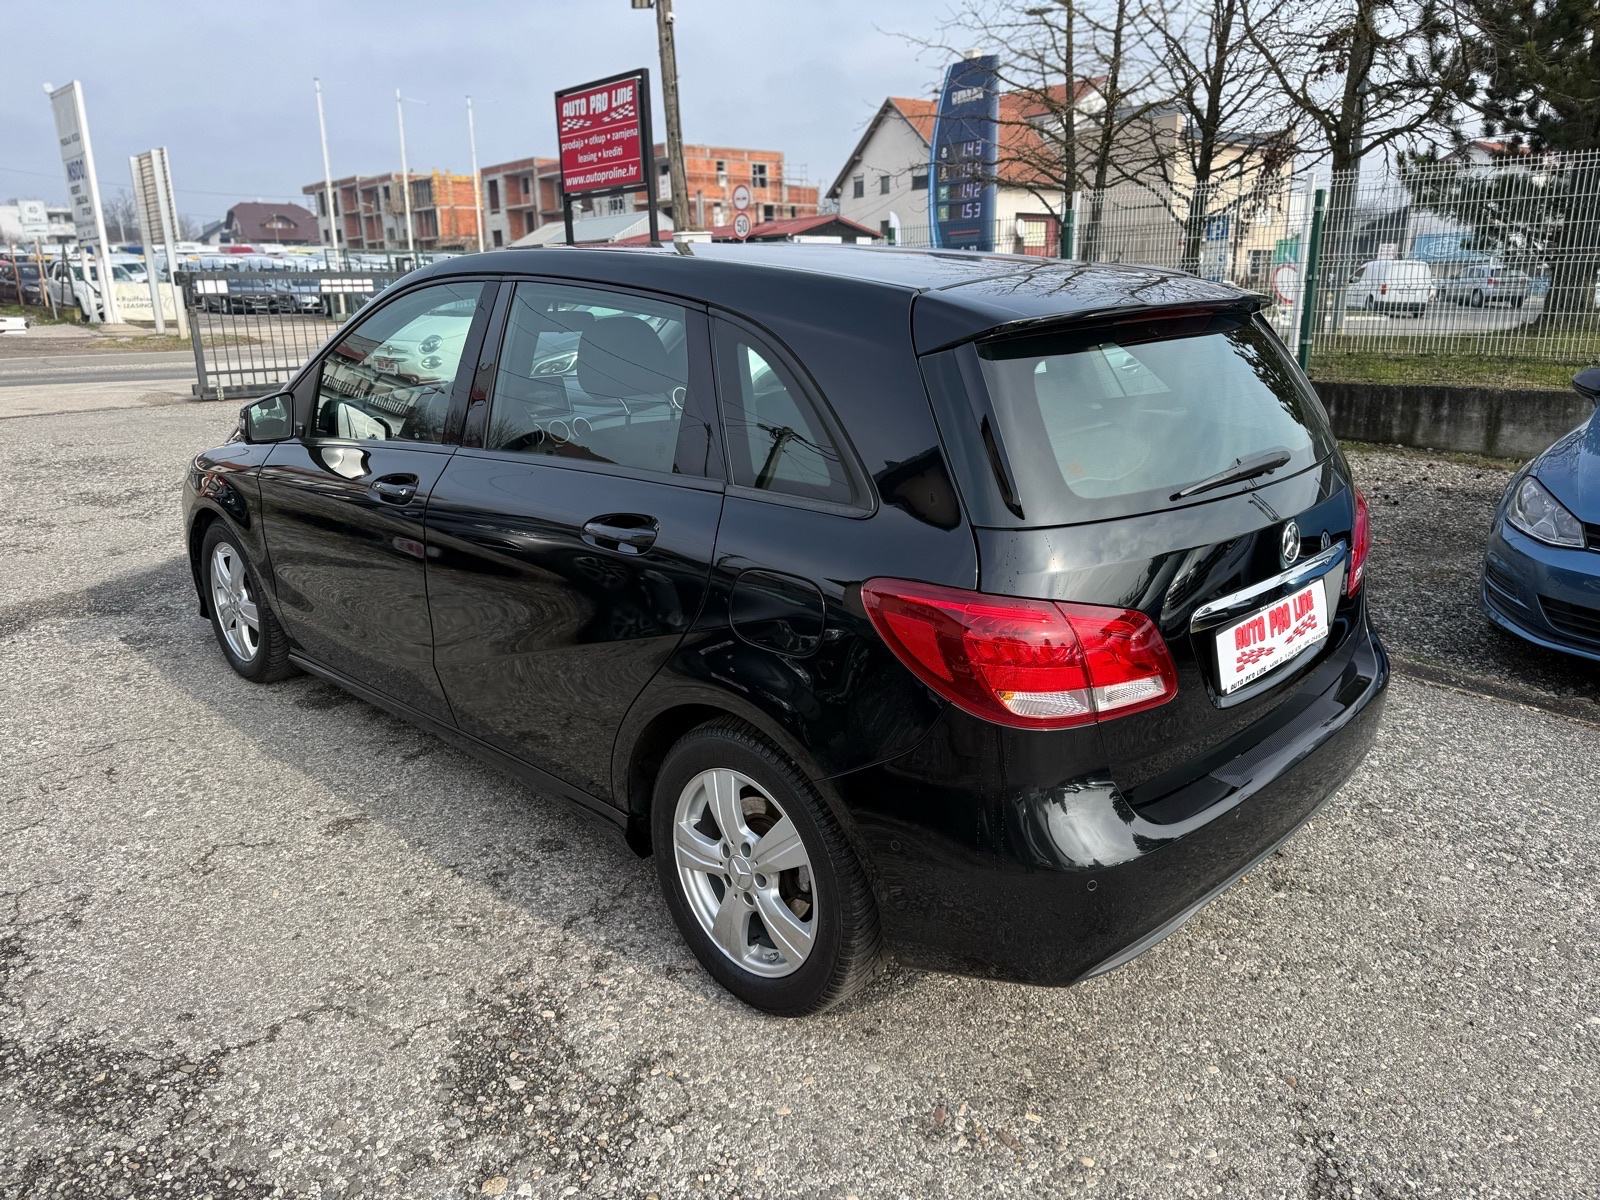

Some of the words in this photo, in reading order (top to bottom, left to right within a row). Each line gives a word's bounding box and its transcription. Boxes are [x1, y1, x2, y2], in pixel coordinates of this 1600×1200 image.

[563, 98, 586, 117] AUTO
[590, 92, 608, 115] PRO
[612, 86, 633, 107] LINE
[562, 139, 584, 152] prodaja
[589, 134, 605, 145] otkup
[612, 127, 638, 140] zamjena
[578, 153, 597, 163] leasing
[603, 146, 623, 158] krediti
[566, 164, 637, 186] www.autoproline.hr
[737, 220, 747, 232] 50
[1235, 616, 1266, 650] AUTO
[1269, 603, 1291, 638] PRO
[1293, 590, 1314, 622] LINE
[1231, 679, 1244, 690] AUTO
[1245, 672, 1255, 682] PRO
[1257, 666, 1267, 675] LINE
